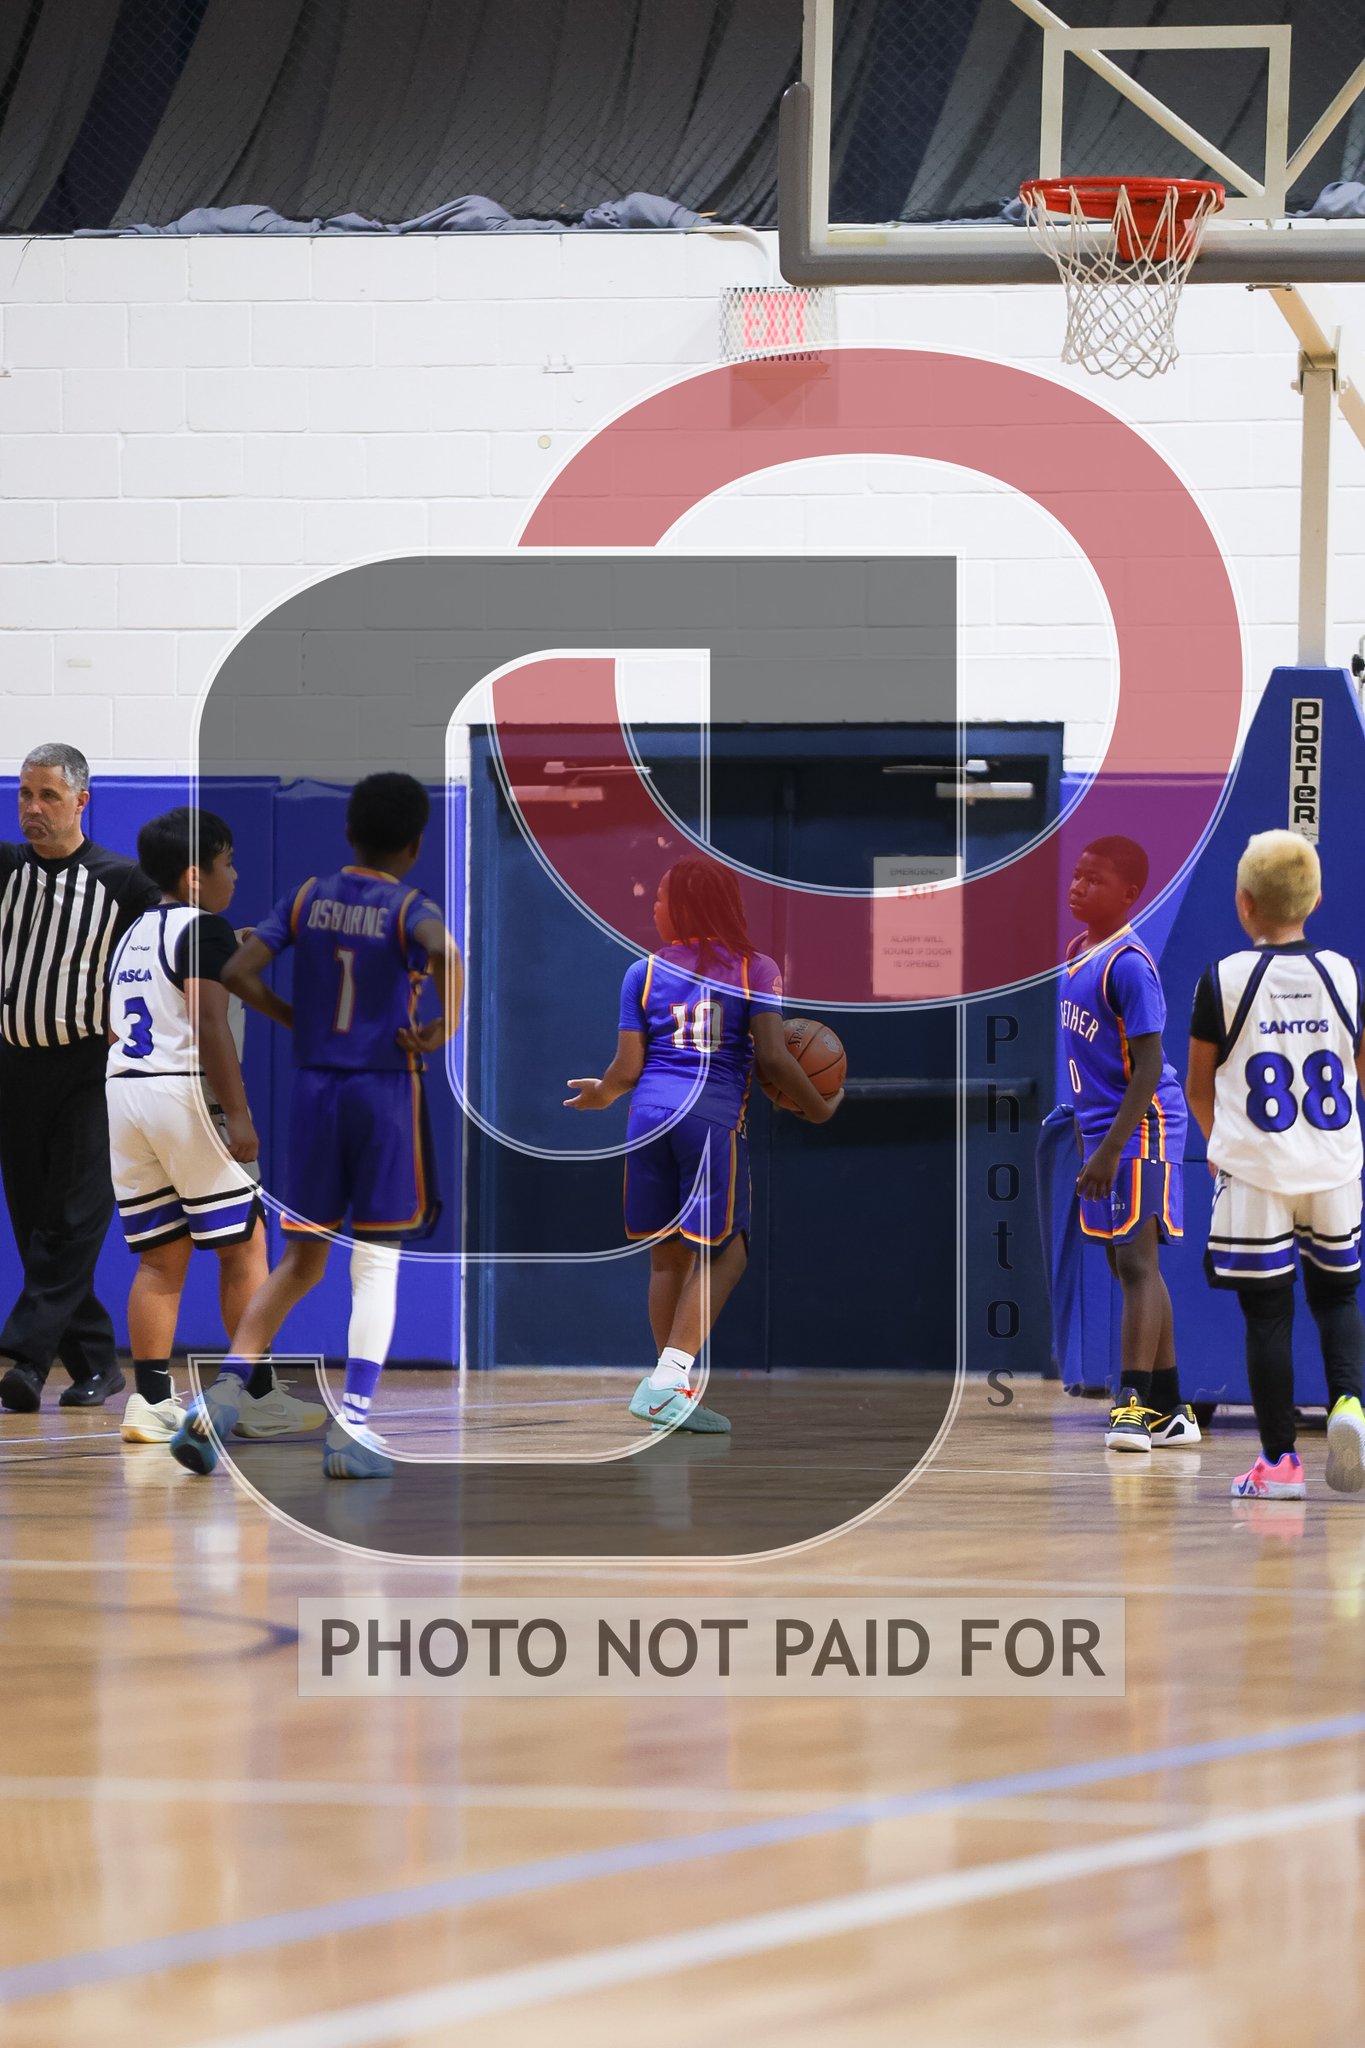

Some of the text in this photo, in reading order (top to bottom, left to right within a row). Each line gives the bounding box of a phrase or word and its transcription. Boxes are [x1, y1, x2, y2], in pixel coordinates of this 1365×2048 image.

[743, 293, 808, 348] EXIT
[1293, 702, 1320, 824] PORTER
[897, 884, 938, 900] EXIT
[335, 947, 354, 1033] 1
[122, 996, 154, 1059] 3
[670, 999, 724, 1053] 10
[1259, 1020, 1329, 1035] SANTOS
[1069, 1059, 1081, 1094] 0
[1244, 1049, 1352, 1133] 88
